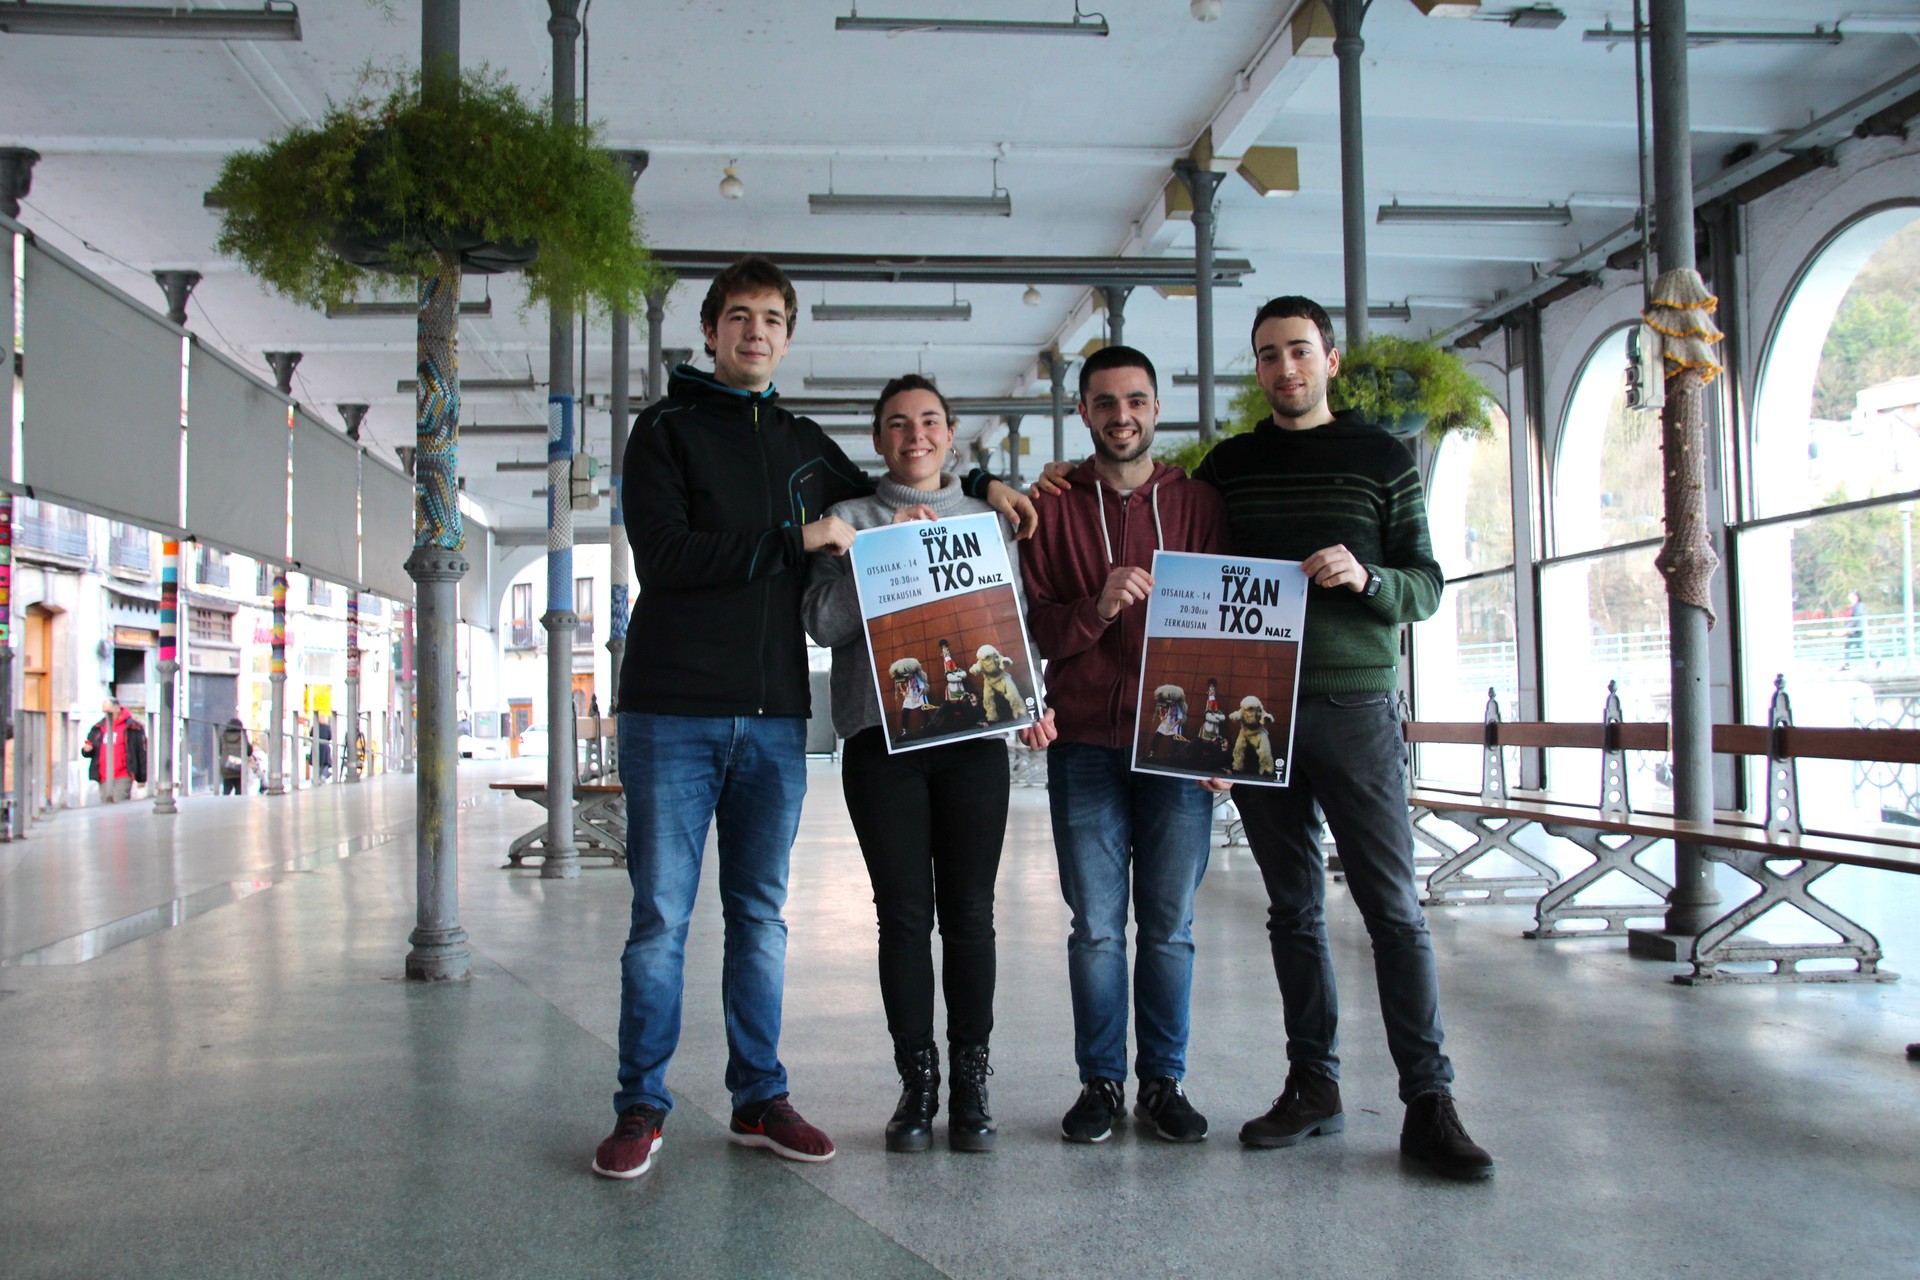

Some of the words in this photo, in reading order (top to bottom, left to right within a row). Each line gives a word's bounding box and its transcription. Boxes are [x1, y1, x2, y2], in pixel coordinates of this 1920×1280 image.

[920, 526, 948, 537] GAUR
[923, 532, 982, 564] TXAN
[867, 562, 901, 576] OTSAILAK
[909, 559, 917, 567] 14
[1222, 565, 1251, 576] GAUR
[928, 562, 974, 593] TXO
[978, 573, 1003, 585] NAIZ
[879, 589, 922, 604] ZERKAUSIAN
[1161, 589, 1195, 599] OTSAILAK
[1202, 592, 1211, 600] 14
[1222, 576, 1280, 607] TXAN
[1164, 618, 1207, 630] ZERKAUSIAN
[1219, 605, 1262, 635] TXO
[1265, 627, 1291, 638] NAIZ
